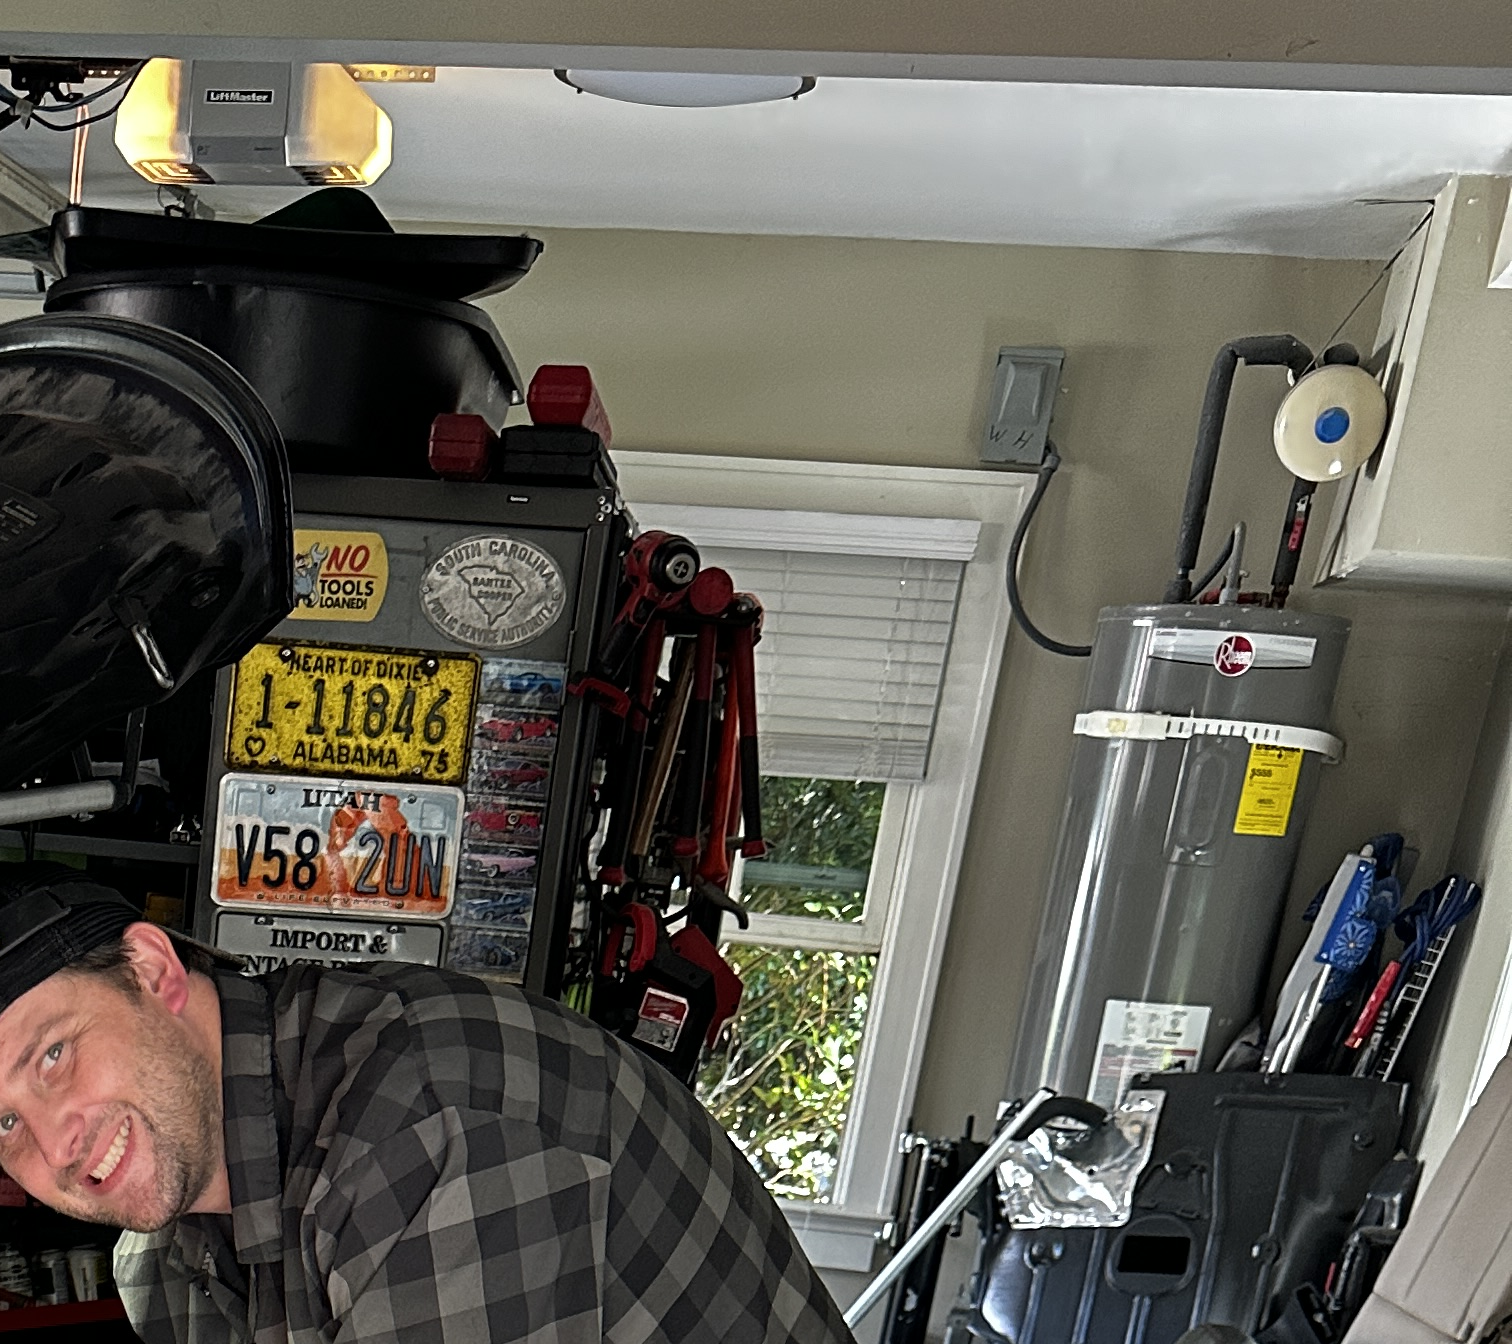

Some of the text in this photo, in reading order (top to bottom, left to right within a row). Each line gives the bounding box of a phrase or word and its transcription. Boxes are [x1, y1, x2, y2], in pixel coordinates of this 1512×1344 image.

[210, 92, 269, 102] LiftMaster
[990, 425, 1035, 450] W H
[325, 545, 371, 572] NO
[435, 540, 557, 582] SOUTH CAROLINA
[319, 578, 374, 598] TOOLS
[472, 576, 513, 589] SANTEE
[319, 596, 368, 611] LOANED!
[427, 599, 555, 644] PUBLIC SERVICE AUTHORITY
[288, 653, 423, 681] HEART OF DIXIE
[255, 672, 452, 745] 1-11846
[292, 741, 449, 774] ALABAMA 75
[301, 788, 383, 813] UTAH
[235, 823, 447, 898] V58 2UN
[274, 894, 390, 907] LIFE ELEVATED
[269, 928, 389, 955] IMPORT &
